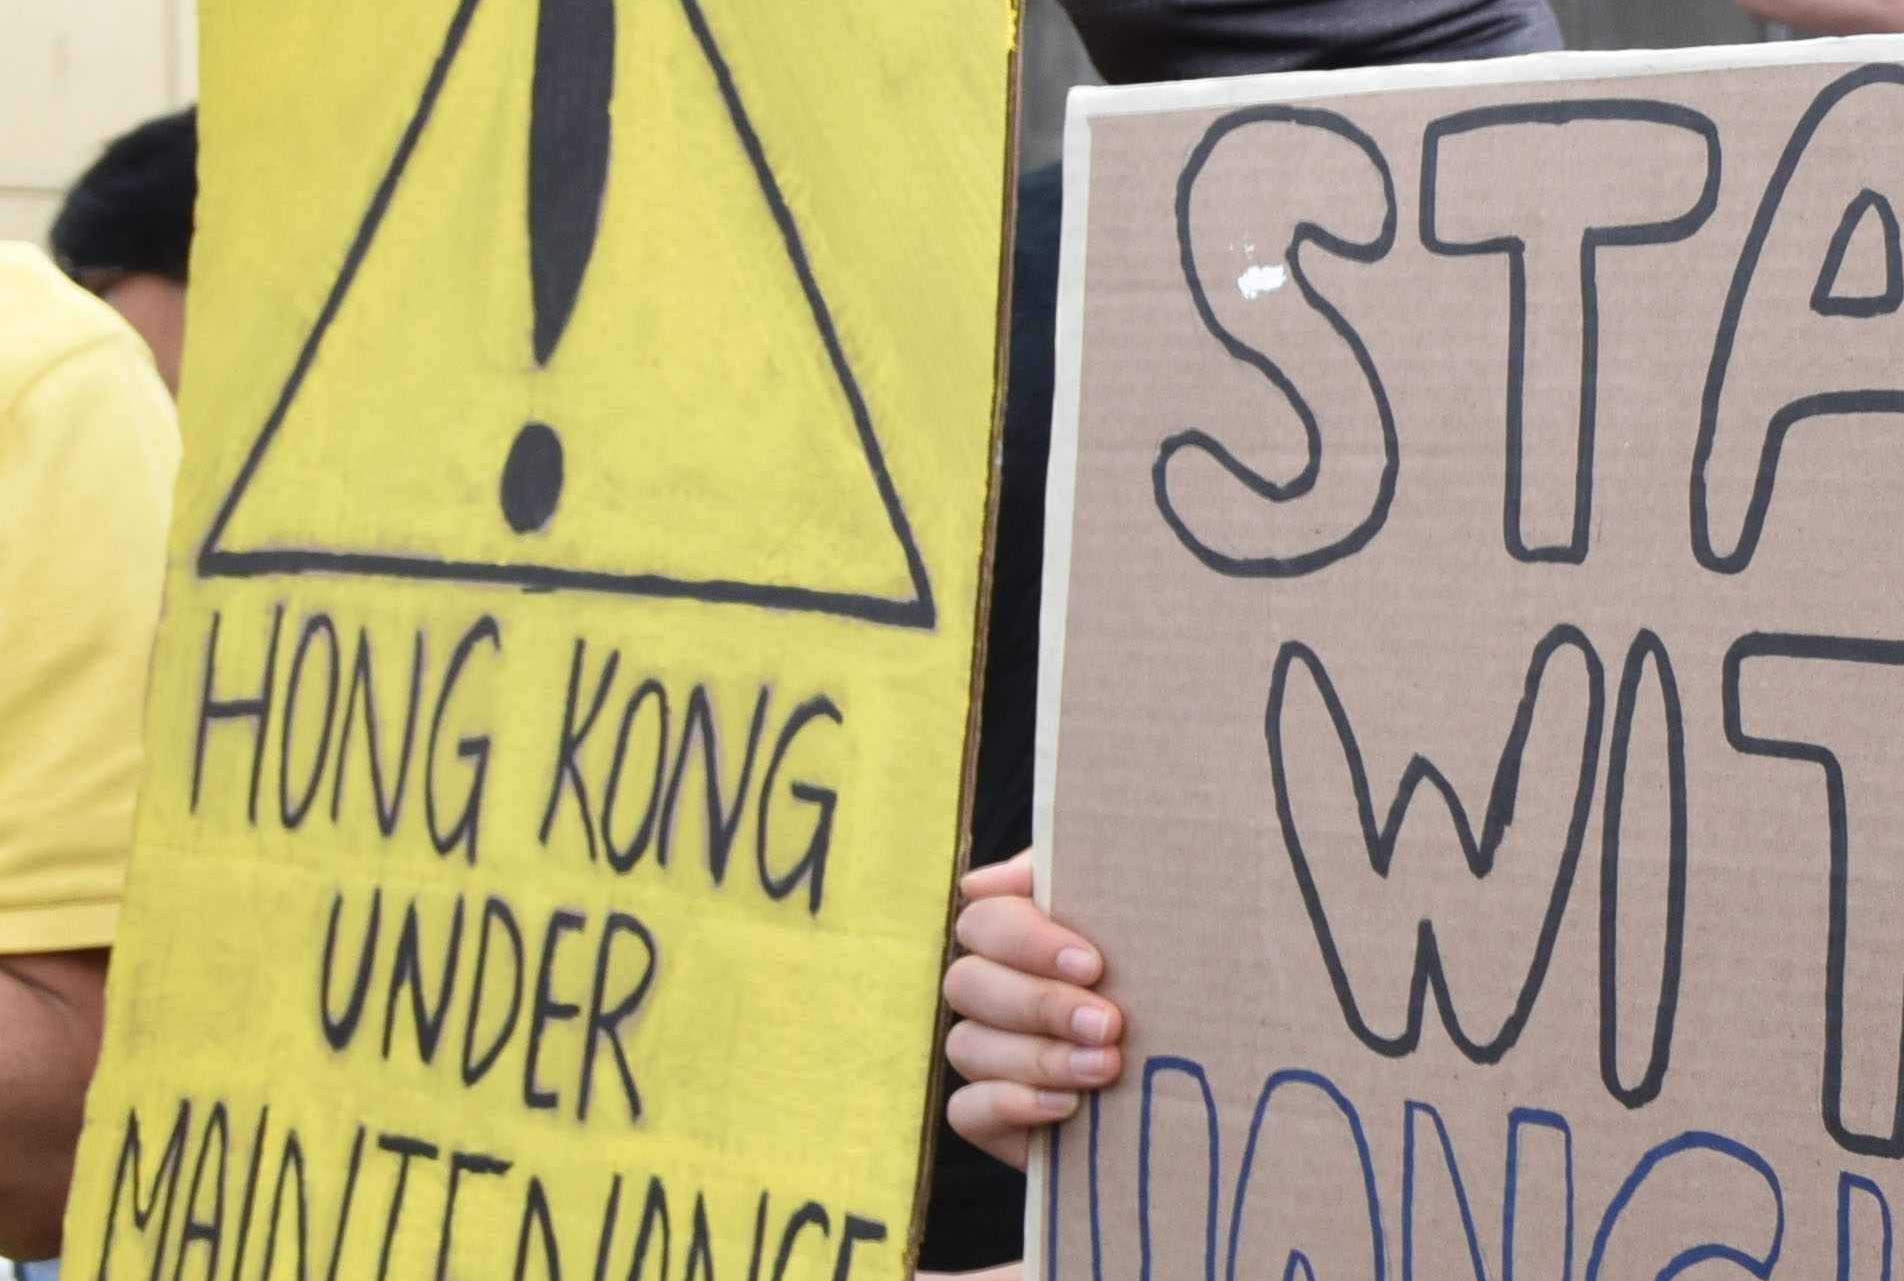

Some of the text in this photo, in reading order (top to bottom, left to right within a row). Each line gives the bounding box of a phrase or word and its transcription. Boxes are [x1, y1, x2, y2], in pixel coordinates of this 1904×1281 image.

[189, 601, 844, 915] HONG KONG
[317, 890, 660, 1123] UNDER
